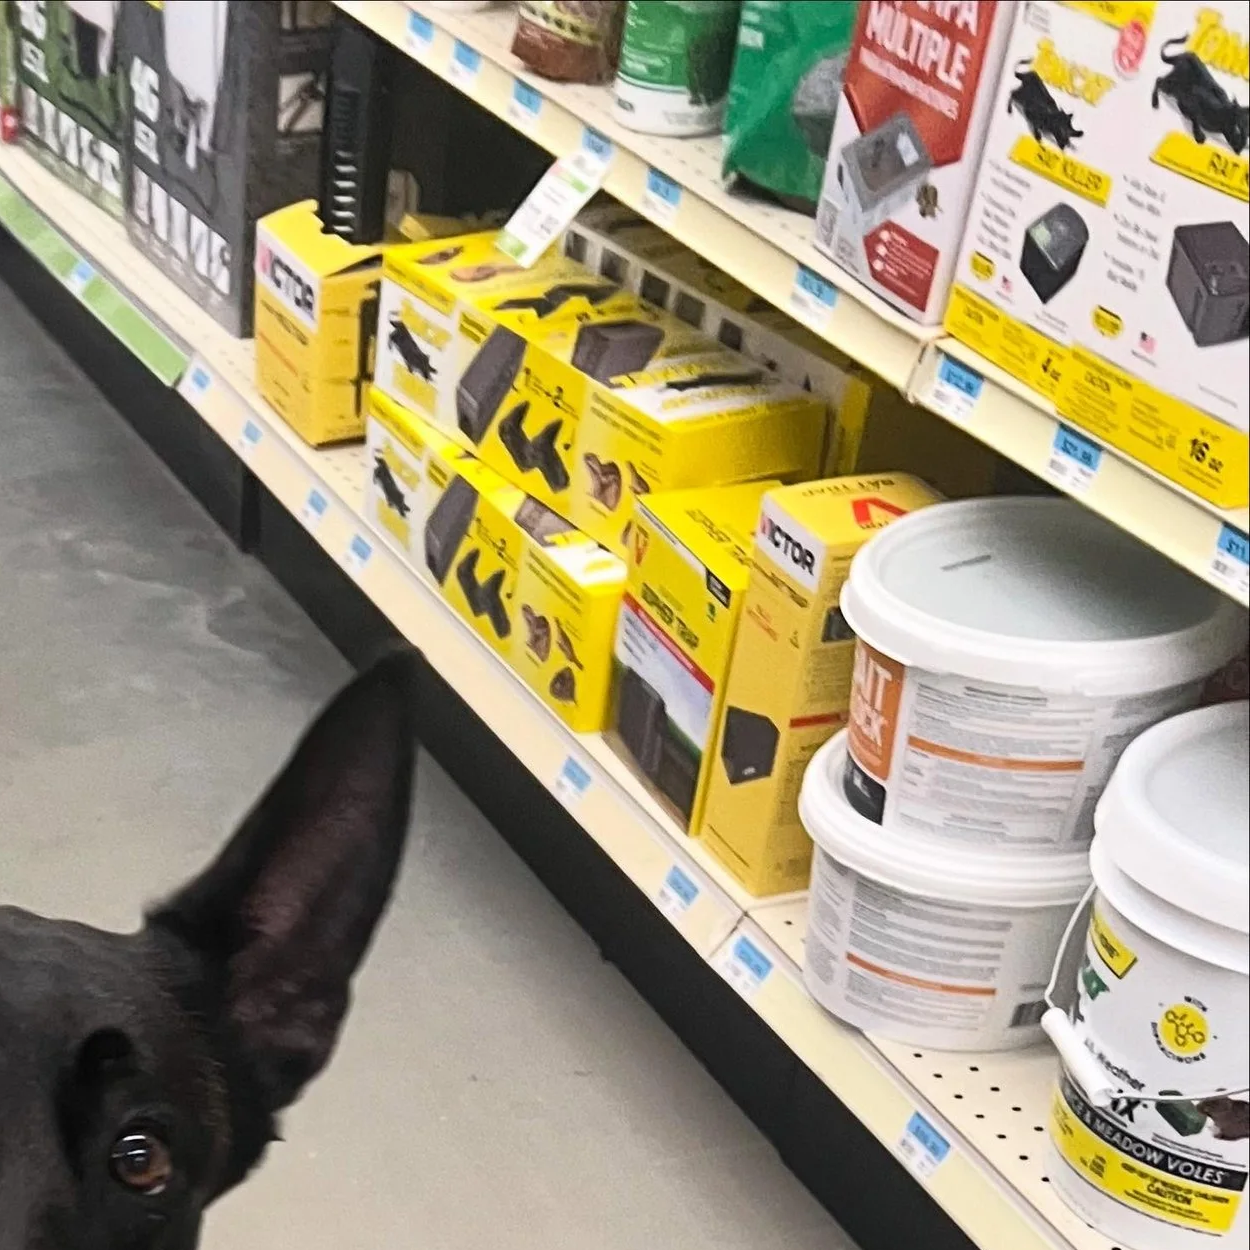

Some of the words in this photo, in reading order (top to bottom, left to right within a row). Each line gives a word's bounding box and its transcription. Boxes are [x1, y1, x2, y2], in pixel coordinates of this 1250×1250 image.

[865, 1, 971, 92] MULTIPLE
[1093, 1116, 1161, 1165] MEADOW
[1167, 1158, 1224, 1185] VOLES
